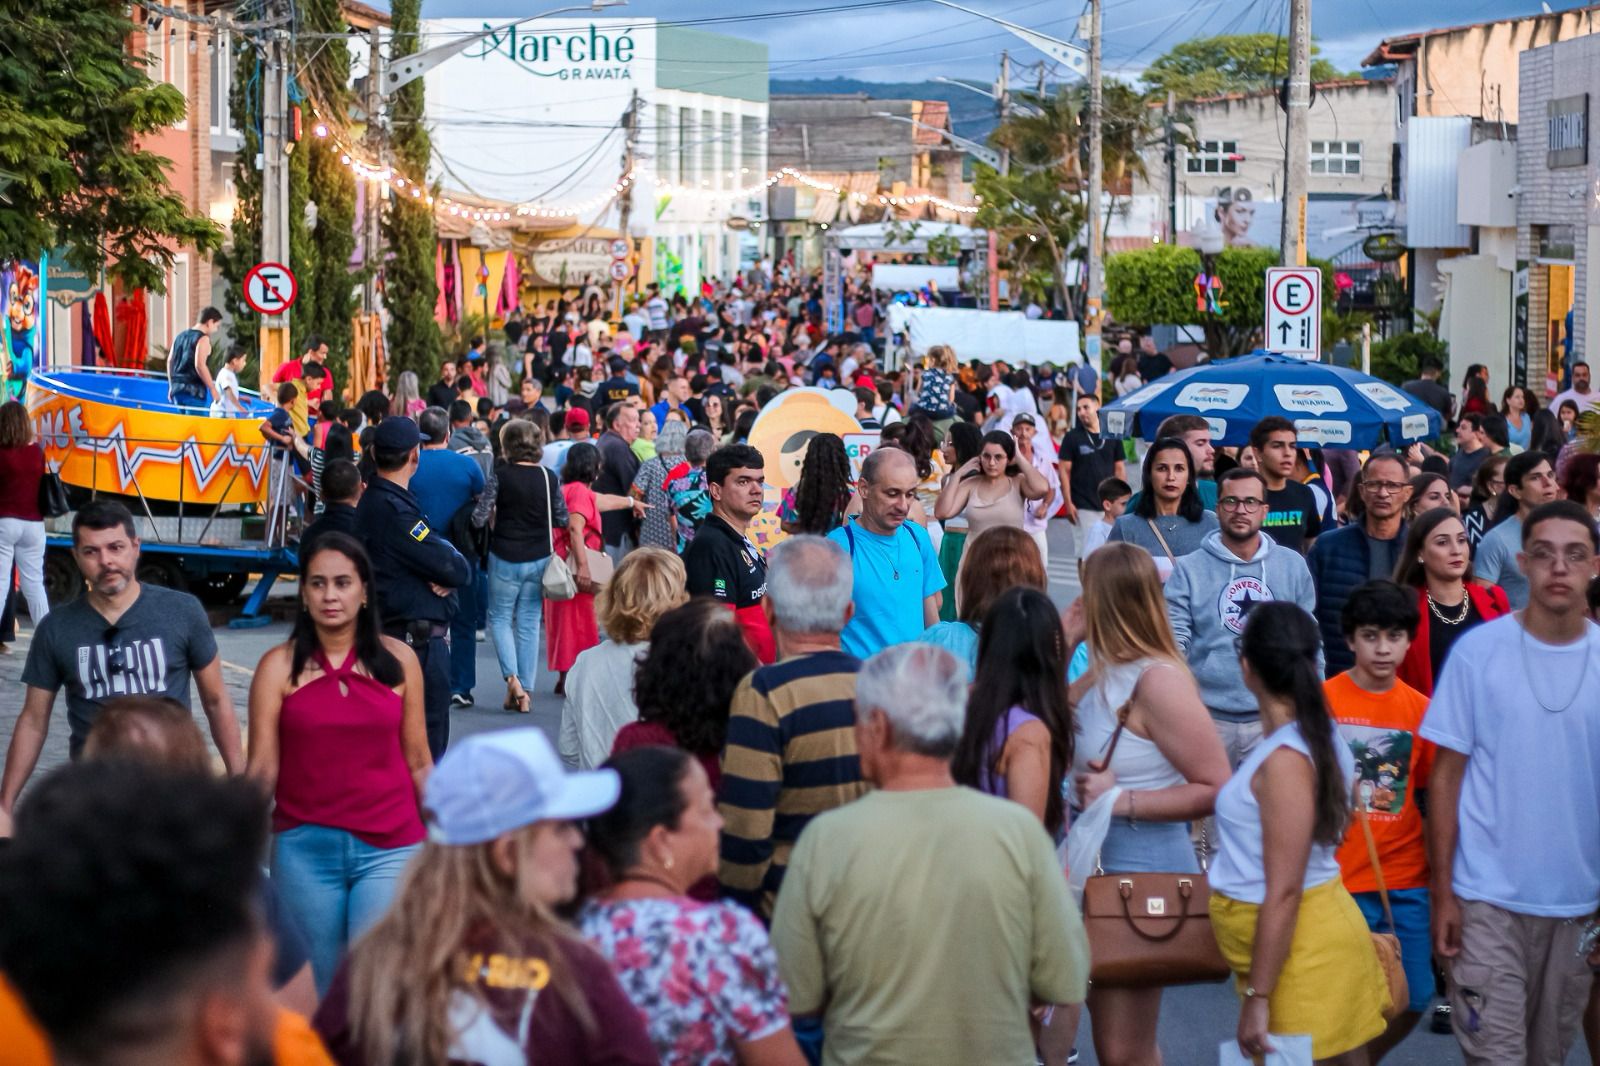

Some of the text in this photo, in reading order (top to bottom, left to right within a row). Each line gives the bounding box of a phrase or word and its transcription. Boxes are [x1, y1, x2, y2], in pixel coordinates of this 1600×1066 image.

[462, 22, 634, 70] Marché
[263, 274, 280, 303] E
[1286, 283, 1301, 307] E
